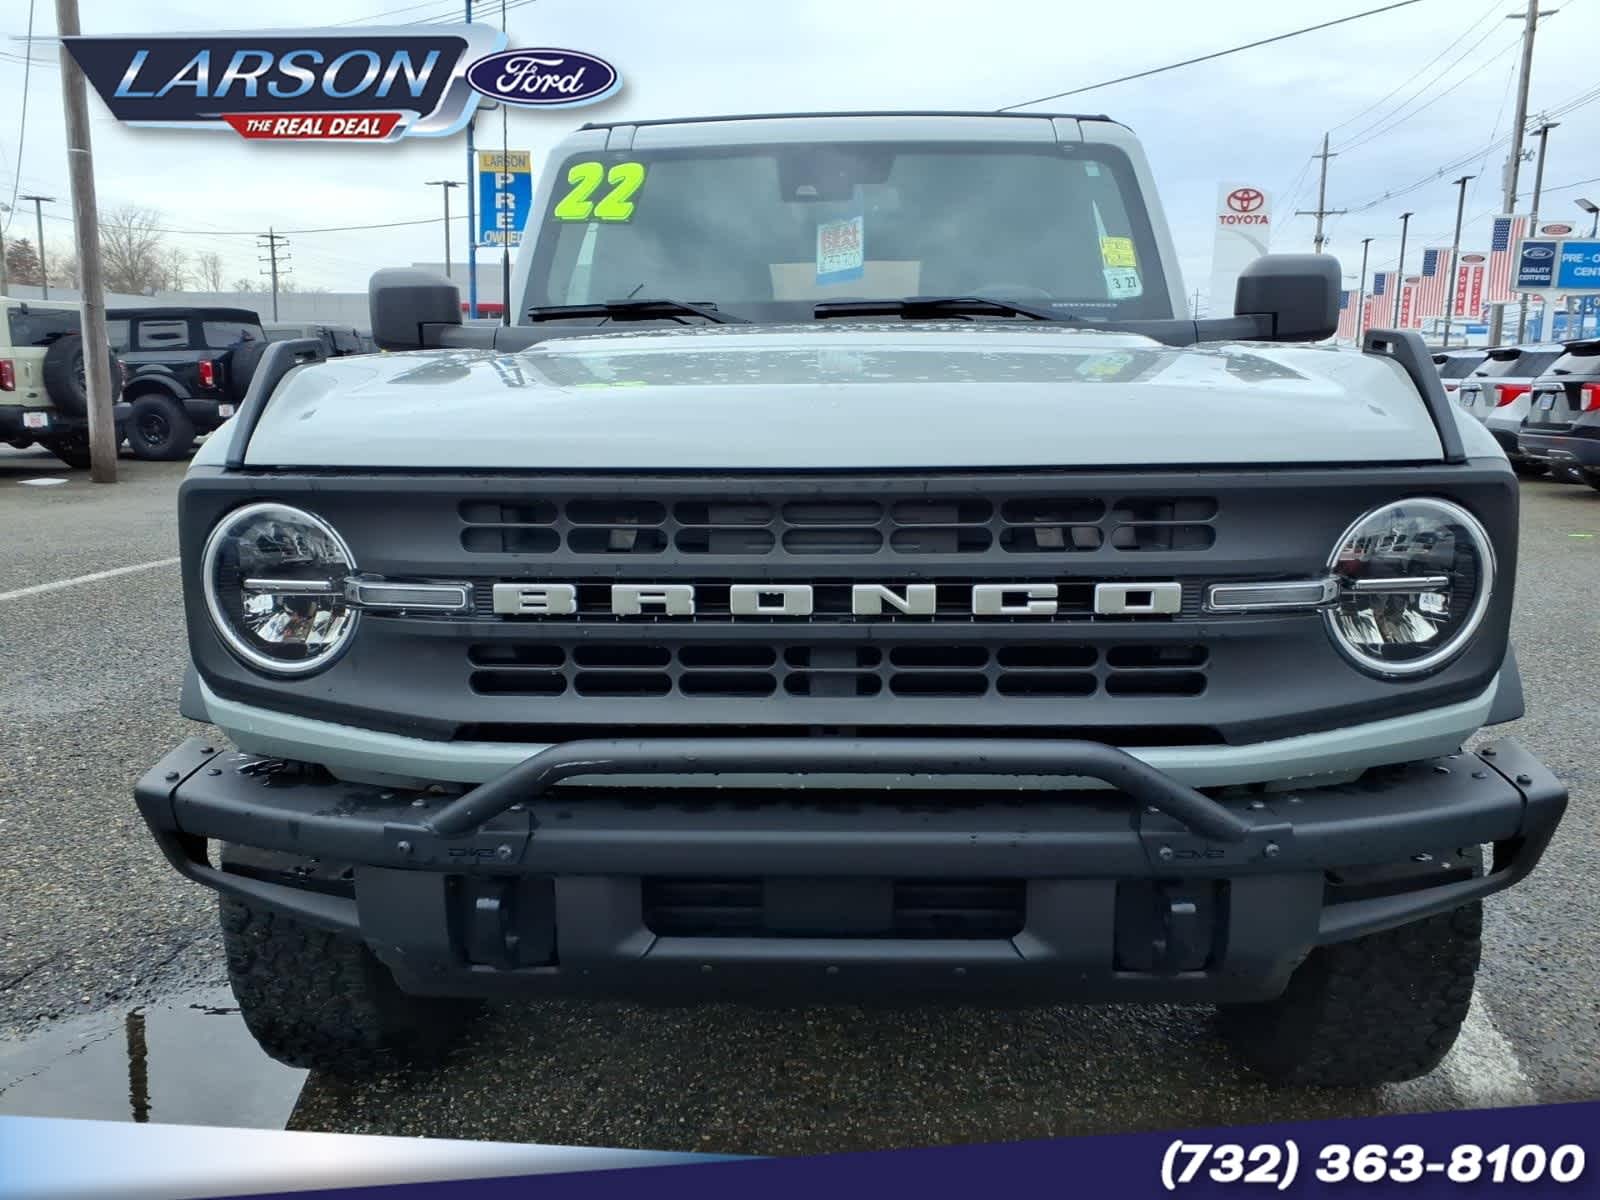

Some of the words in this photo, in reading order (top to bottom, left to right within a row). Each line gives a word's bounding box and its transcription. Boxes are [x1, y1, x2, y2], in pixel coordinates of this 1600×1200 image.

[483, 154, 526, 168] LARSON
[495, 173, 515, 229] PRE
[554, 161, 645, 220] 22
[1219, 215, 1269, 225] TOYOTA
[1522, 266, 1551, 274] QUALITY
[493, 582, 1182, 615] BRONCO
